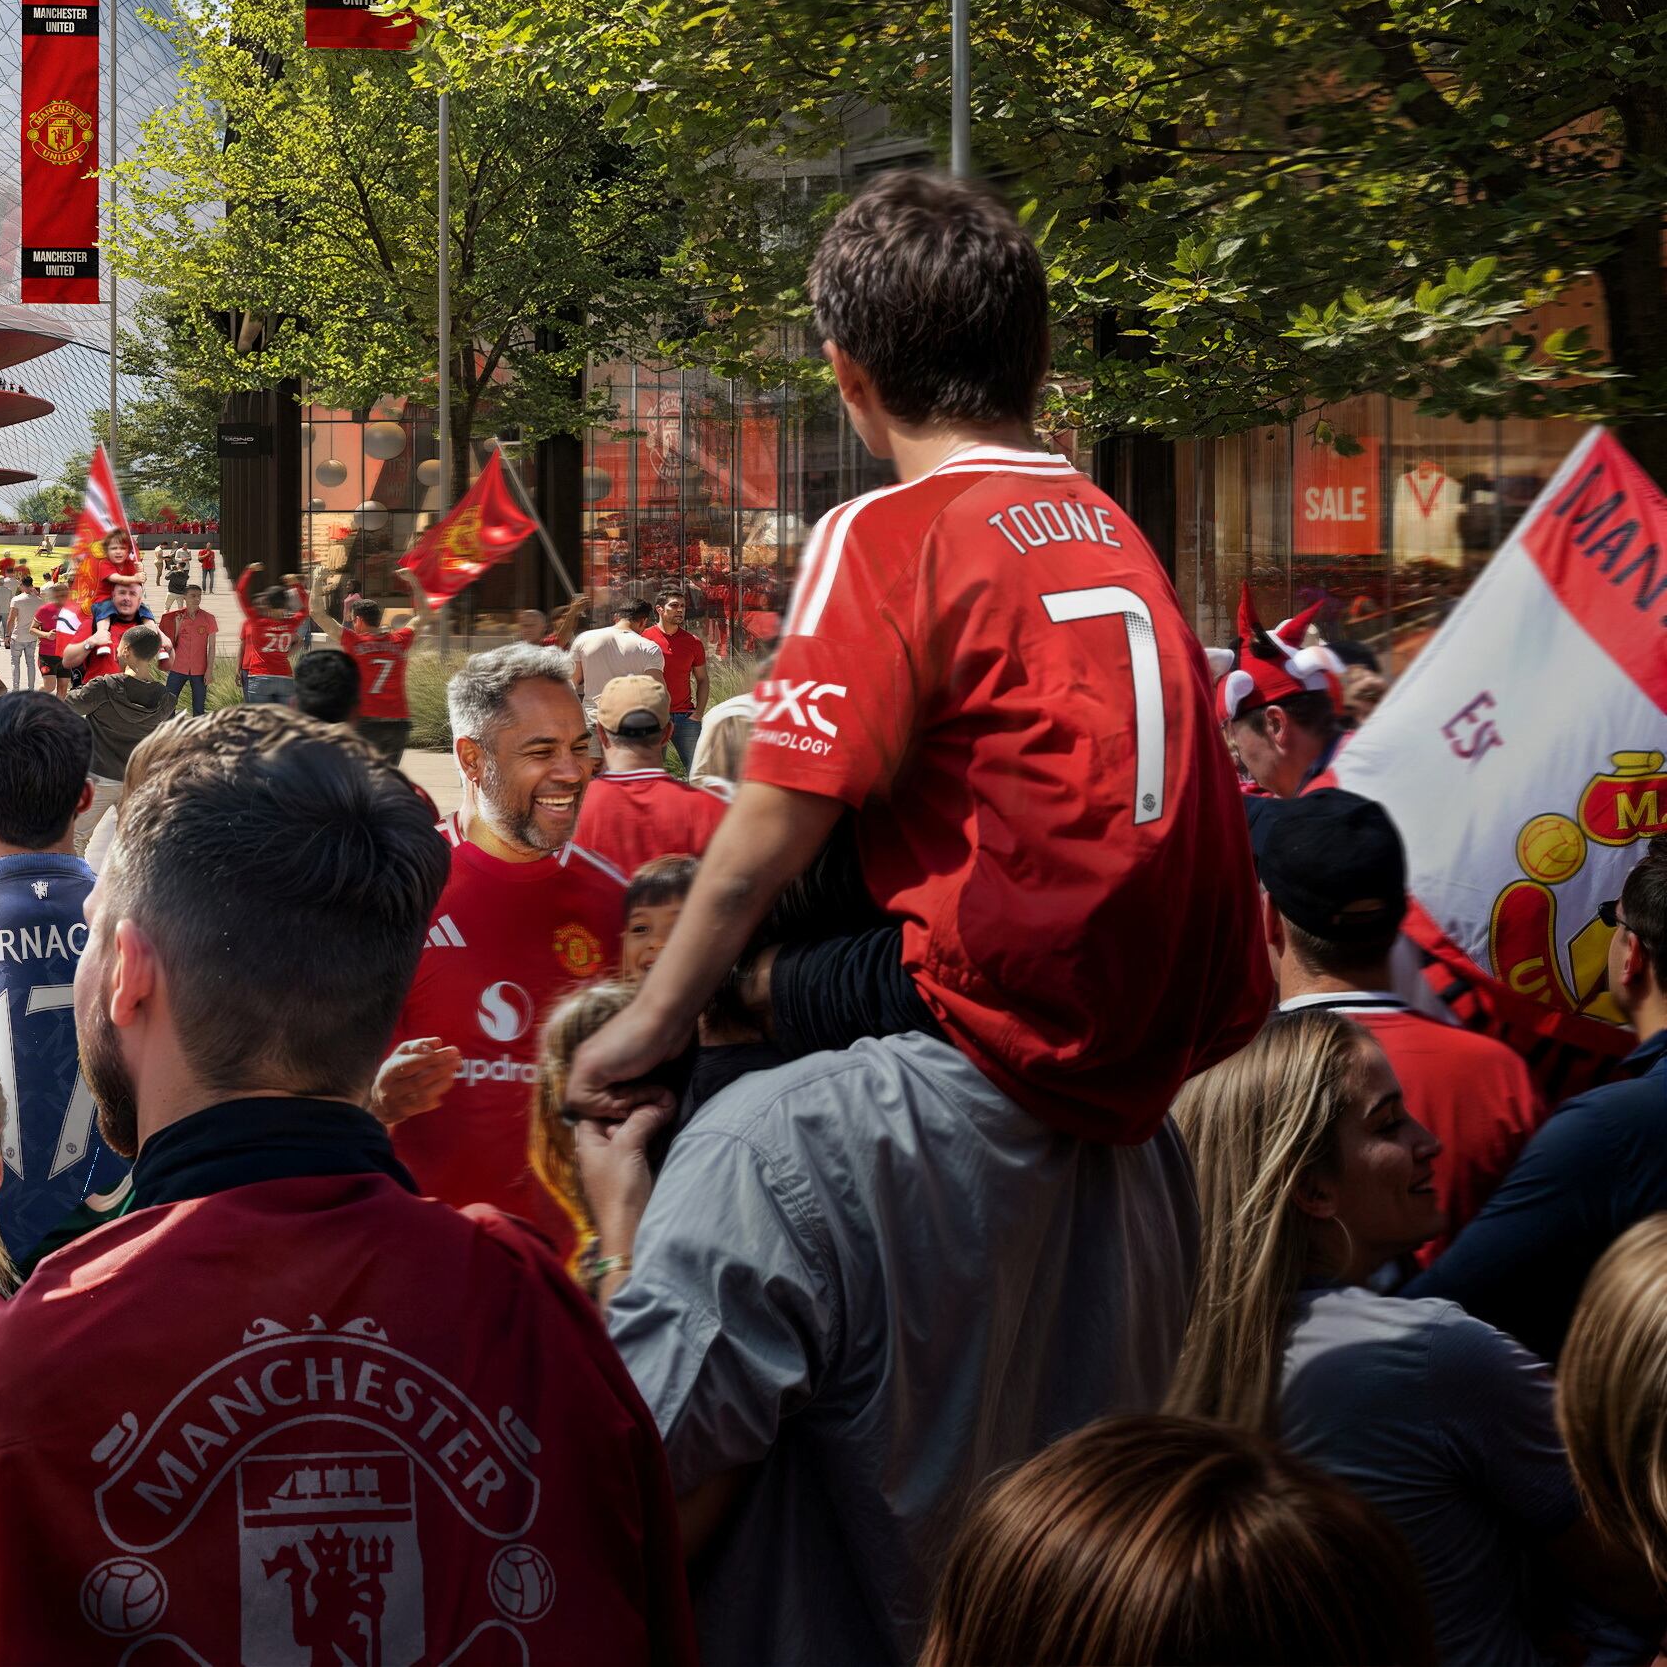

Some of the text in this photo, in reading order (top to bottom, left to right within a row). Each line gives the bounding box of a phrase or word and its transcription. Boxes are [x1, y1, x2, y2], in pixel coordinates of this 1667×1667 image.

[33, 7, 88, 20] MANCHESTER
[45, 21, 75, 33] UNITED
[34, 105, 88, 127] MANCHESTER
[42, 149, 80, 162] UNITED
[32, 250, 88, 263] MANCHESTER
[45, 264, 75, 277] UNITED
[1304, 486, 1367, 522] SALE
[988, 500, 1123, 555] TOONE
[261, 632, 293, 653] 20
[370, 658, 396, 695] 7
[1038, 585, 1166, 826] 7
[133, 1356, 508, 1514] MANCHESTER
